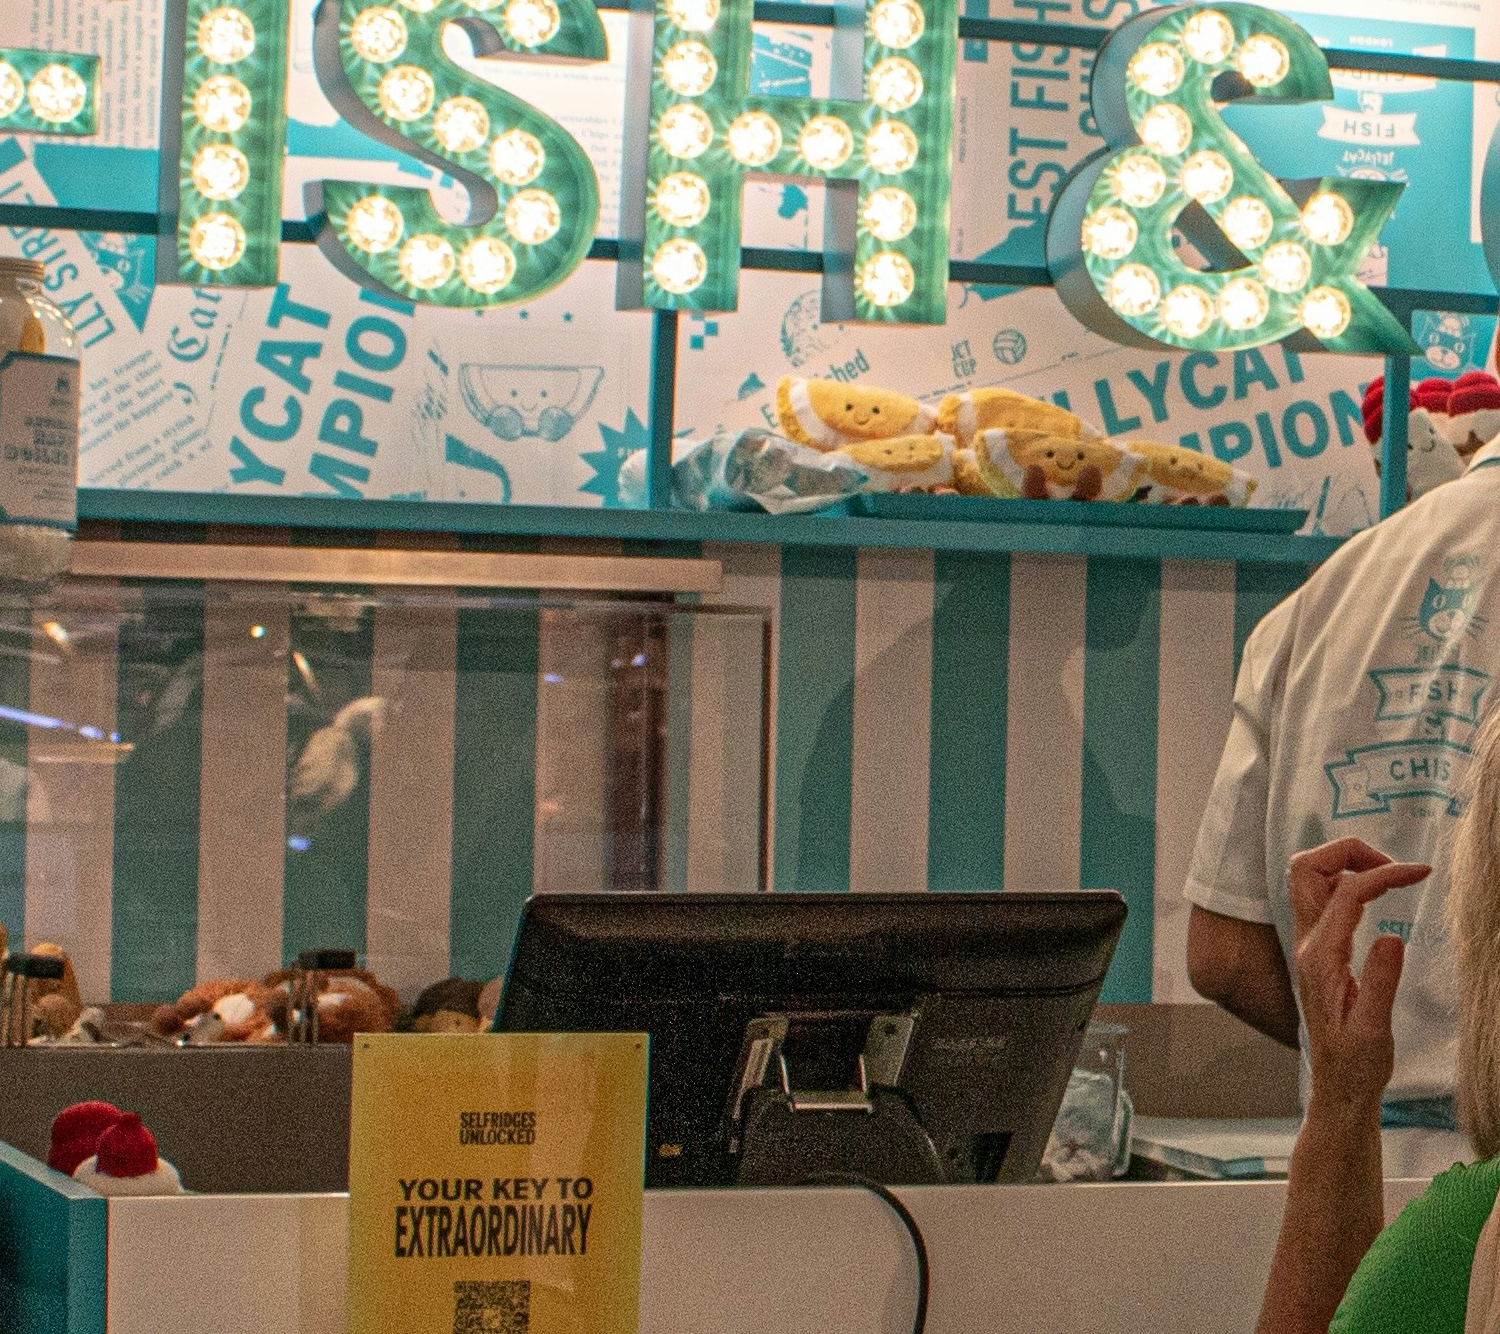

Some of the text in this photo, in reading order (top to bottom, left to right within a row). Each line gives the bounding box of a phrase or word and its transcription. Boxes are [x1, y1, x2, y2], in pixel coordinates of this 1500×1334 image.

[1342, 119, 1396, 138] FISH
[1046, 0, 1425, 355] &
[459, 1110, 537, 1128] SELFRIDGES
[459, 1128, 537, 1147] UNLOCKED
[399, 1177, 593, 1202] YOUR KEY TO
[394, 1203, 593, 1259] EXTRAORDINARY
